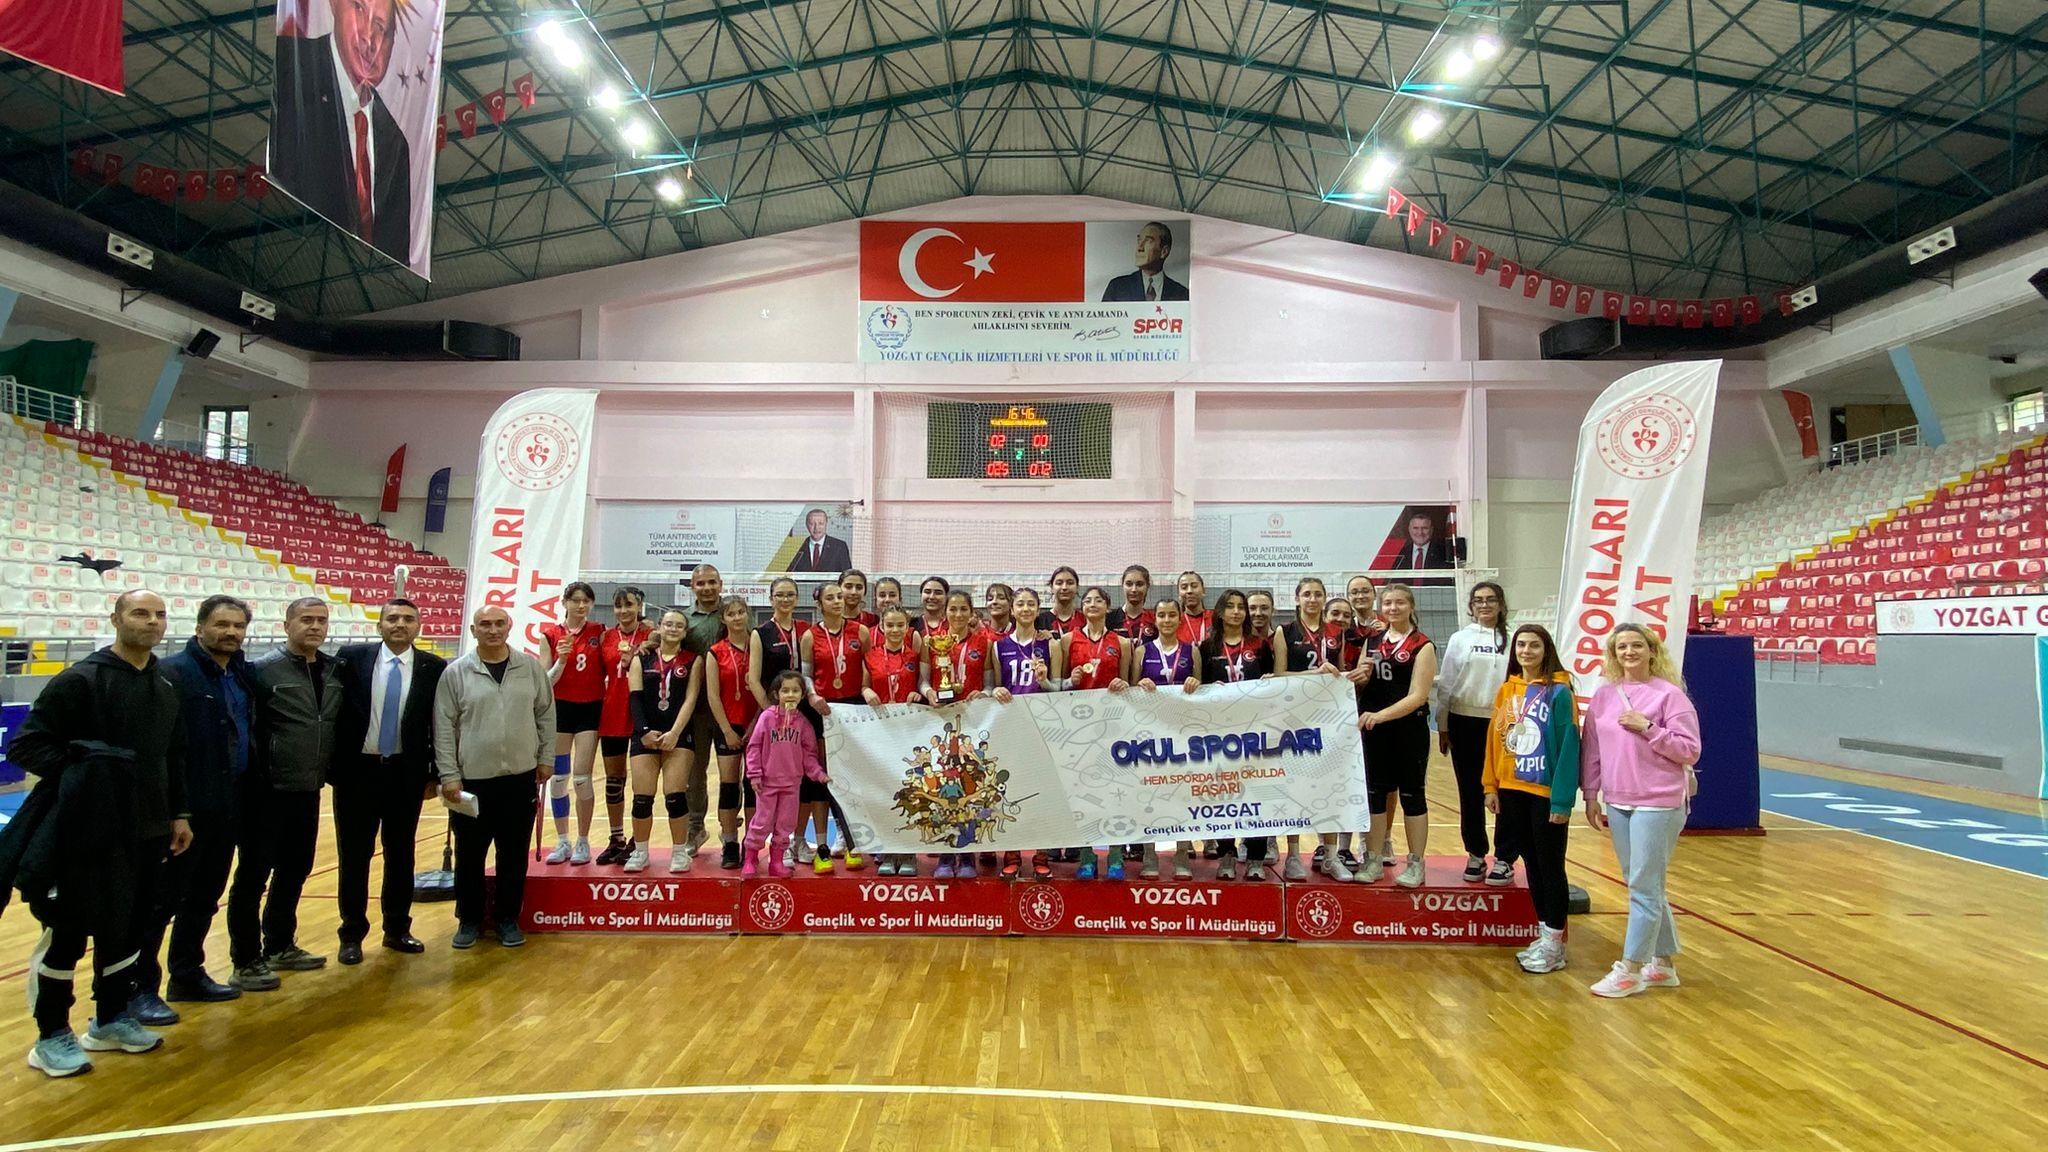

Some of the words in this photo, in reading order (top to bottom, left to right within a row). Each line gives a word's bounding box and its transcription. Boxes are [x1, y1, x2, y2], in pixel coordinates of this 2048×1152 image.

[915, 310, 934, 318] BEN
[936, 310, 989, 318] SPORCUNUN
[1018, 309, 1046, 320] ÇEVİK
[1049, 310, 1060, 318] VE
[1063, 310, 1084, 318] AYNI
[1086, 310, 1129, 318] ZAMANDA
[972, 322, 1028, 330] AHLAKLISINI
[1133, 319, 1183, 334] SPOR
[880, 351, 922, 362] YOZGAT
[926, 349, 973, 363] GENÇLİK
[977, 349, 1043, 362] HİZMETLERİ
[1047, 351, 1060, 362] VE
[1064, 351, 1092, 362] SPOR
[1096, 349, 1107, 362] İL
[1110, 349, 1179, 362] MÜDÜRLÜĞÜ
[649, 532, 665, 540] TÜM
[667, 532, 707, 540] ANTRENÖR
[1241, 545, 1258, 553] TÜM
[1260, 545, 1300, 553] ANTRENÖR
[1244, 553, 1309, 561] SPORCULARIMIZA
[1934, 606, 2028, 627] YOZGAT
[576, 653, 586, 672] 8
[1008, 659, 1034, 686] 18
[1111, 738, 1187, 765] OKUL
[1188, 728, 1323, 760] SPORLARI
[1144, 776, 1168, 785] HEM
[1170, 773, 1214, 784] SPORDA
[1215, 771, 1239, 782] HEM
[1241, 768, 1286, 779] OKULDA
[1191, 782, 1241, 797] BAŞARI
[1188, 803, 1261, 820] YOZGAT
[1144, 824, 1185, 836] Gençlik
[1206, 822, 1231, 834] Spor
[1248, 817, 1311, 831] Müdürlüğü
[588, 883, 680, 901] YOZGAT
[859, 884, 949, 902] YOZGAT
[1130, 887, 1222, 906] YOZGAT
[1409, 893, 1503, 912] YOZGAT
[533, 911, 585, 928] Gençlik
[589, 915, 605, 925] ve
[608, 912, 640, 928] Spor
[643, 909, 652, 925] İl
[656, 911, 733, 929] Müdürlüğü
[803, 912, 856, 929] Gençlik
[860, 917, 875, 927] ve
[879, 914, 910, 929] Spor
[914, 910, 923, 927] İl
[927, 913, 1003, 930] Müdürlüğü
[1074, 915, 1127, 932] Gençlik
[1131, 920, 1147, 930] ve
[1150, 917, 1182, 932] Spor
[1186, 914, 1195, 931] İl
[1199, 917, 1276, 935] Müdürlüğü
[1353, 920, 1407, 938] Gençlik
[1411, 926, 1428, 937] ve
[1431, 922, 1465, 939] Spor
[1468, 919, 1478, 937] İl
[1482, 923, 1541, 938] Müdürlü
